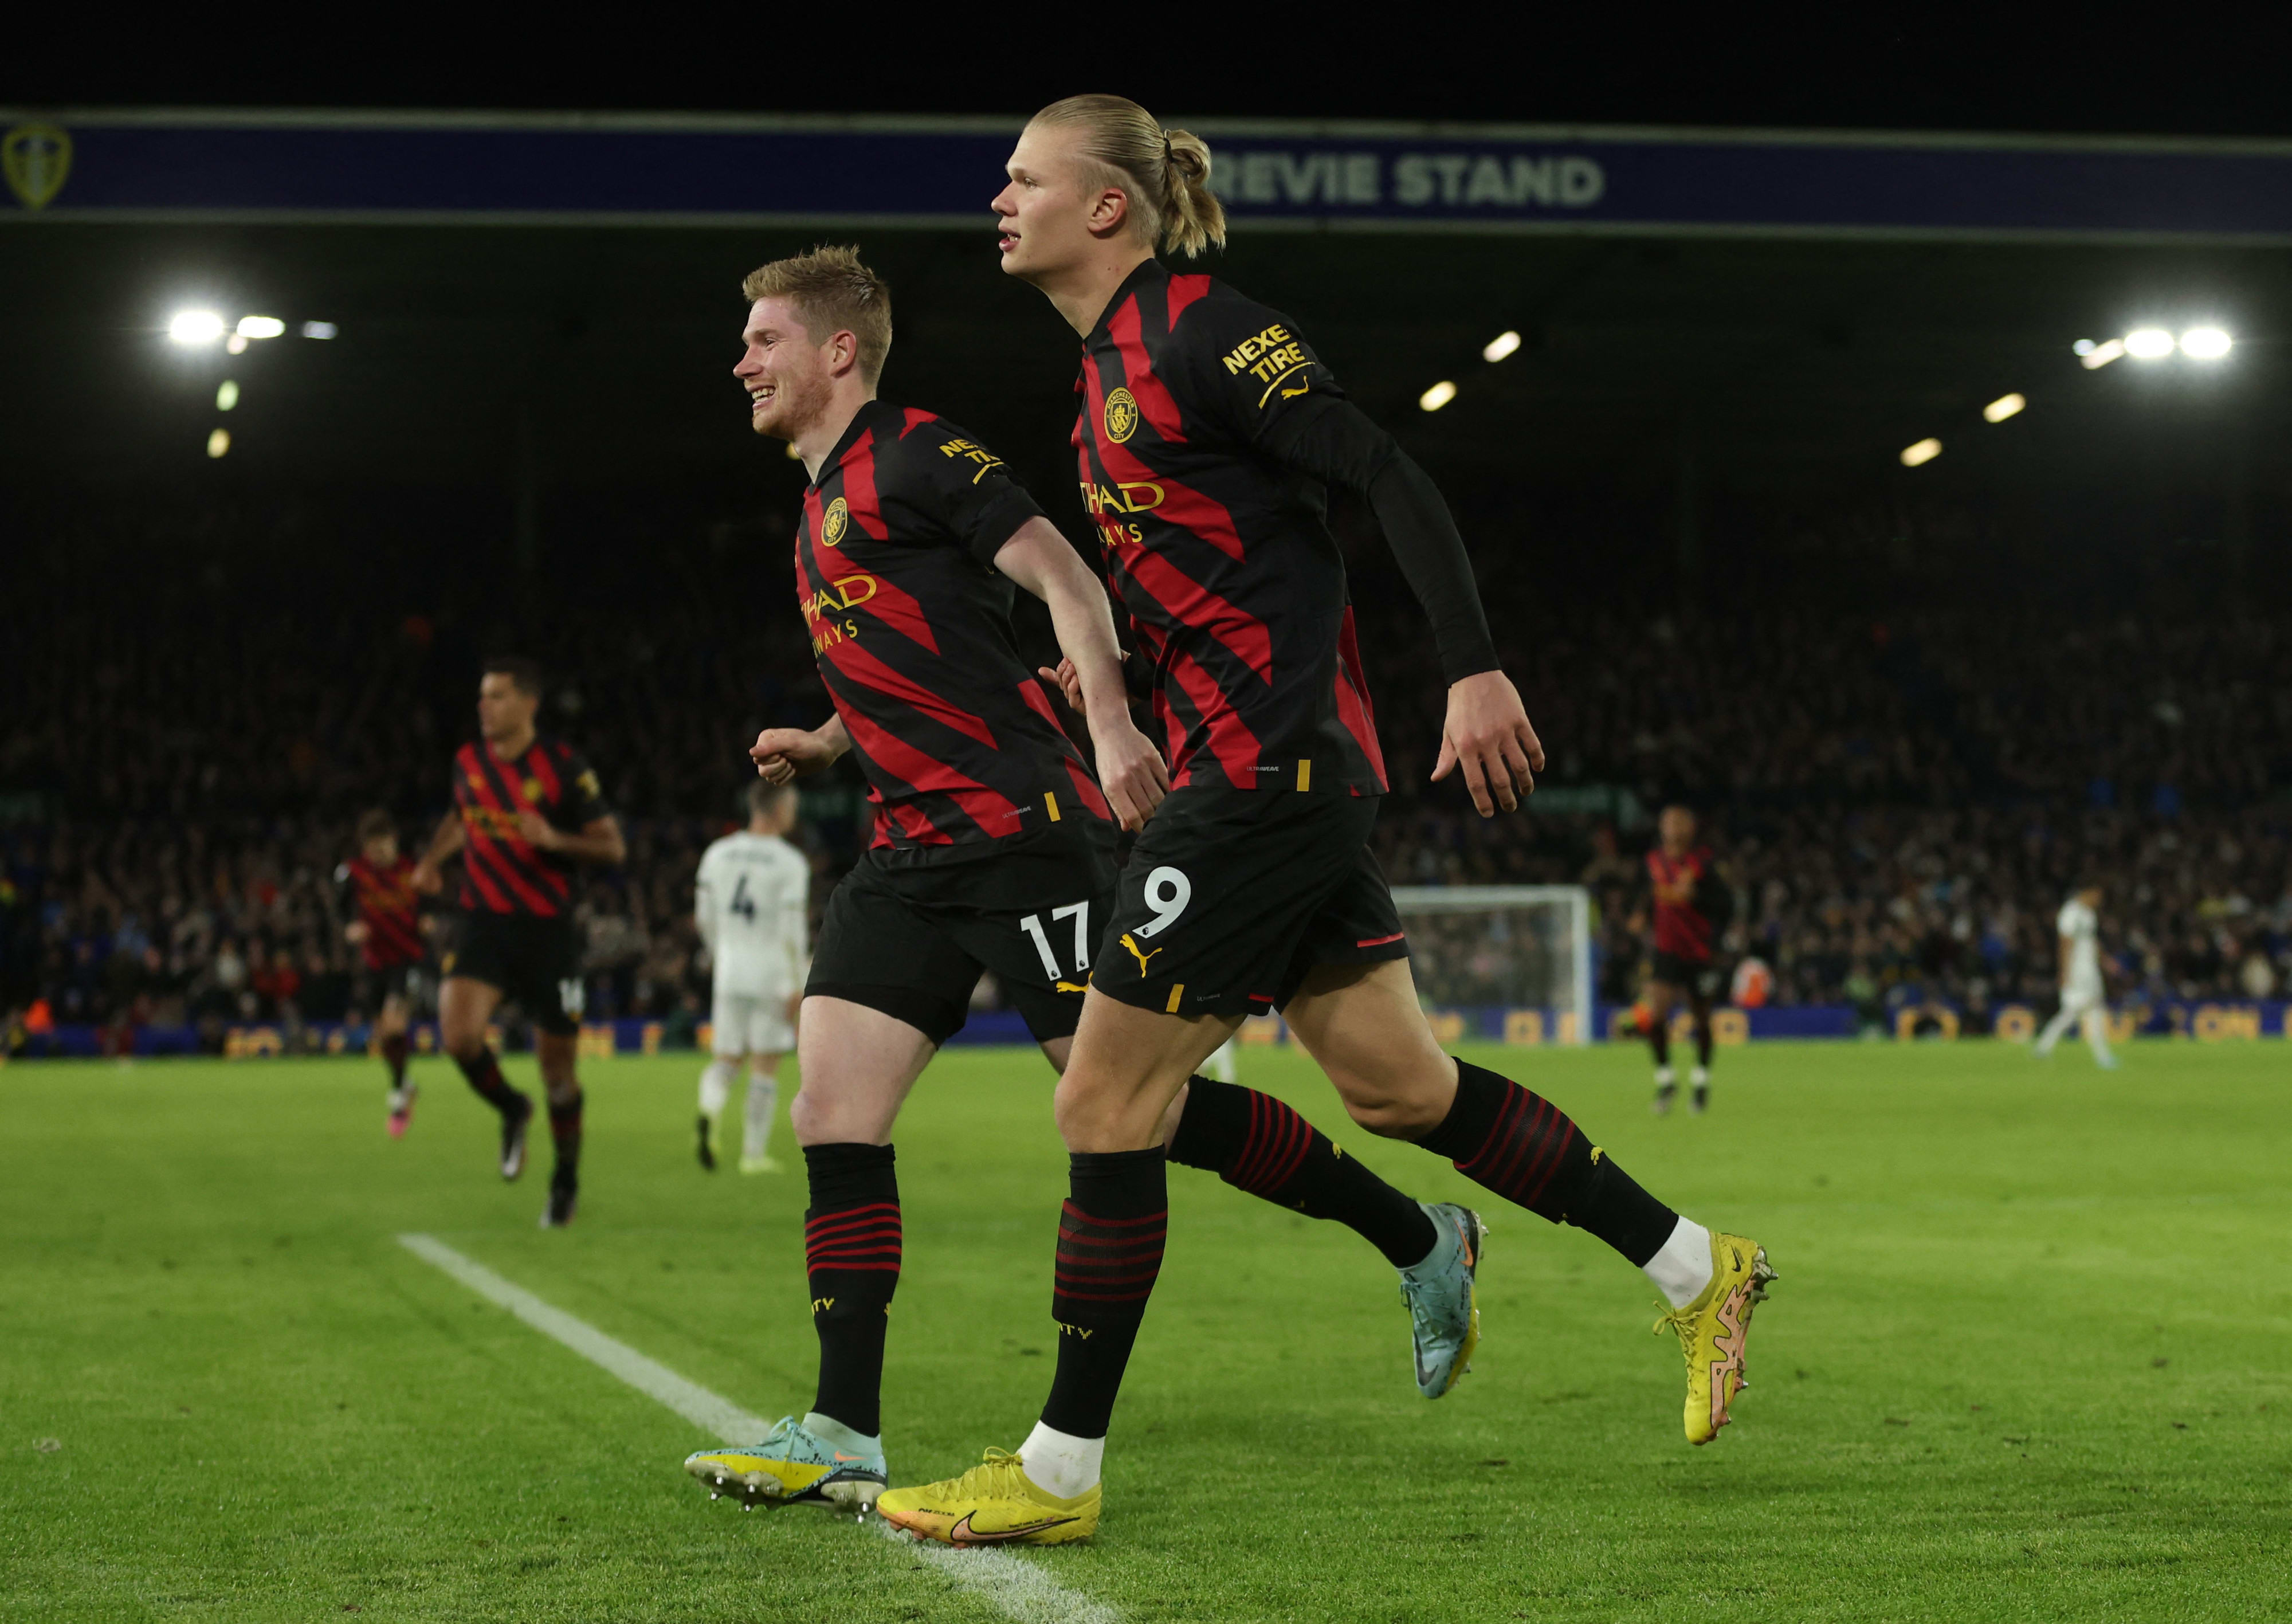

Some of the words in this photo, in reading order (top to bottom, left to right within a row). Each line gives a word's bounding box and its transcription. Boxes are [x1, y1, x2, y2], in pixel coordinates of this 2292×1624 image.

[1207, 154, 1378, 202] REVIE
[1395, 156, 1603, 204] STAND
[1222, 324, 1292, 375] NEXE
[1249, 342, 1306, 383] TIRE
[939, 439, 979, 458] NE
[964, 449, 1000, 463] TI
[730, 873, 755, 923] 4
[1132, 866, 1191, 939] 9
[1020, 899, 1089, 981] 17
